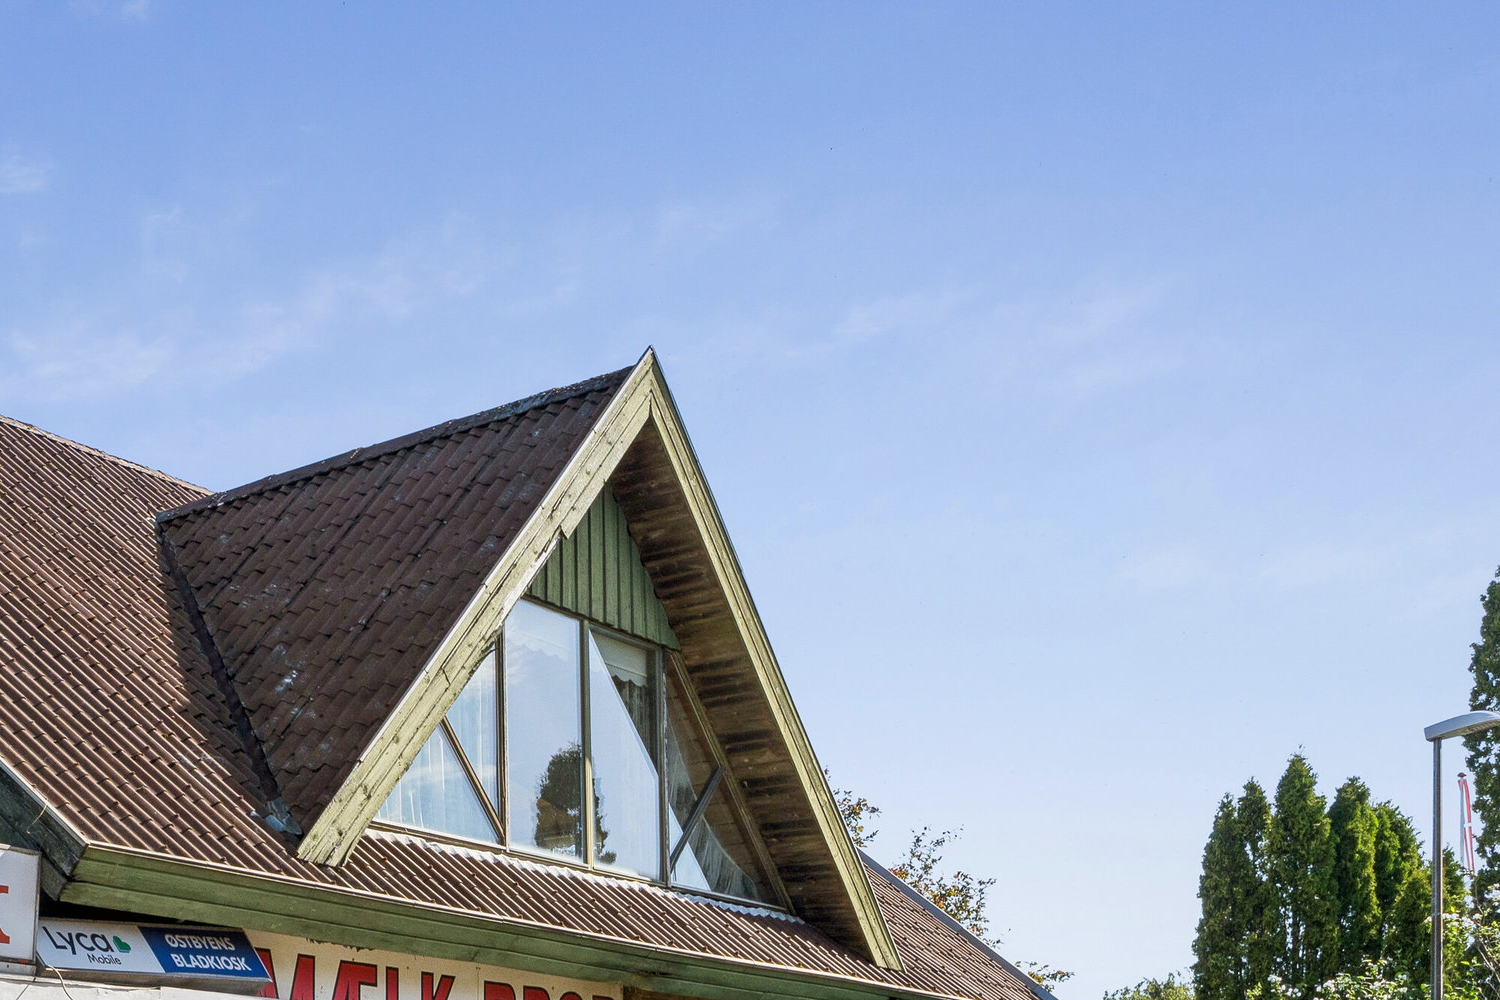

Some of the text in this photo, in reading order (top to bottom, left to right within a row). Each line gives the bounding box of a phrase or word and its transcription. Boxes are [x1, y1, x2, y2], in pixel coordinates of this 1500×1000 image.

[42, 925, 115, 955] Lyca
[164, 933, 236, 951] ØSTBYENS
[87, 953, 122, 966] Mobile
[169, 953, 253, 972] BLADKIOSK
